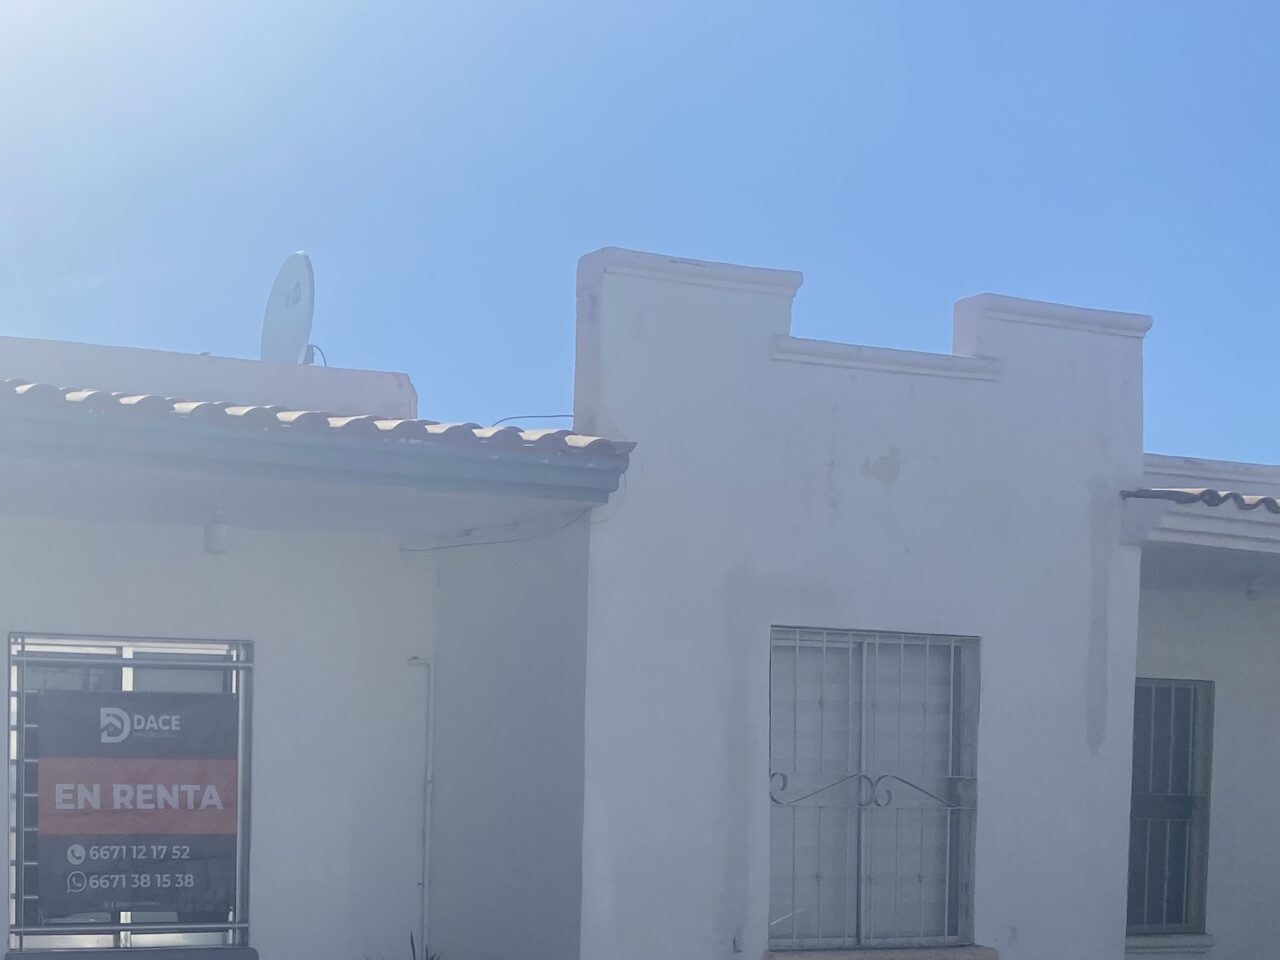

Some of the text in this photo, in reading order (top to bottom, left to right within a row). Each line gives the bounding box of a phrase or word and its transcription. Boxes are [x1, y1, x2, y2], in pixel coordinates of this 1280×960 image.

[133, 713, 180, 731] DACE
[55, 783, 224, 811] EN RENTA
[88, 845, 191, 860] 6671 12 17 52
[88, 873, 194, 889] 6671 38 15 38
